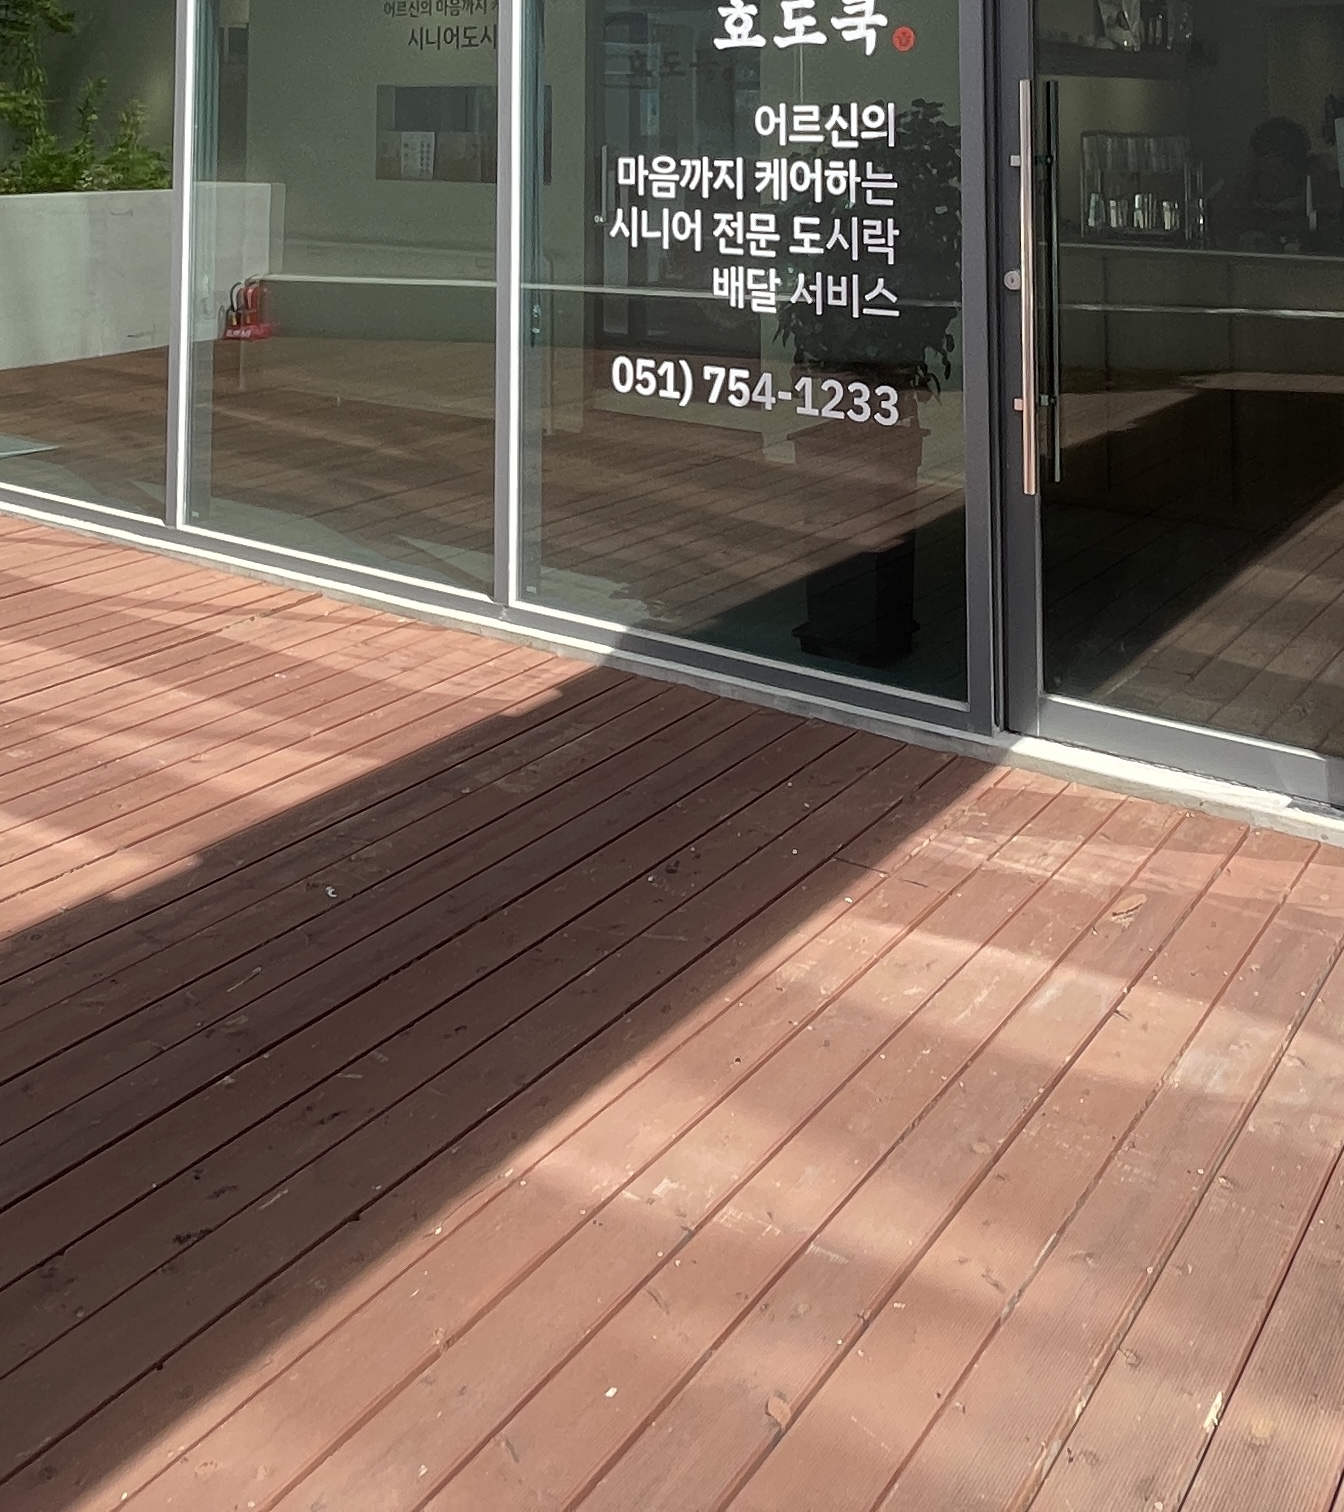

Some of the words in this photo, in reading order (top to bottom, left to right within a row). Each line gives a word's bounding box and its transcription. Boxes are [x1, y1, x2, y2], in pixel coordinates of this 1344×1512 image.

[383, 0, 433, 18] 어르신의
[754, 102, 896, 149] 어르신의
[617, 154, 745, 201] 마음까지
[754, 157, 898, 208] 케어하는
[609, 205, 703, 253] 시니어
[712, 211, 781, 258] 전문
[788, 216, 900, 265] 도시락
[712, 265, 782, 314] 배달
[788, 271, 900, 318] 서비스
[611, 355, 694, 407] 051)
[703, 365, 900, 426] 754-1233
